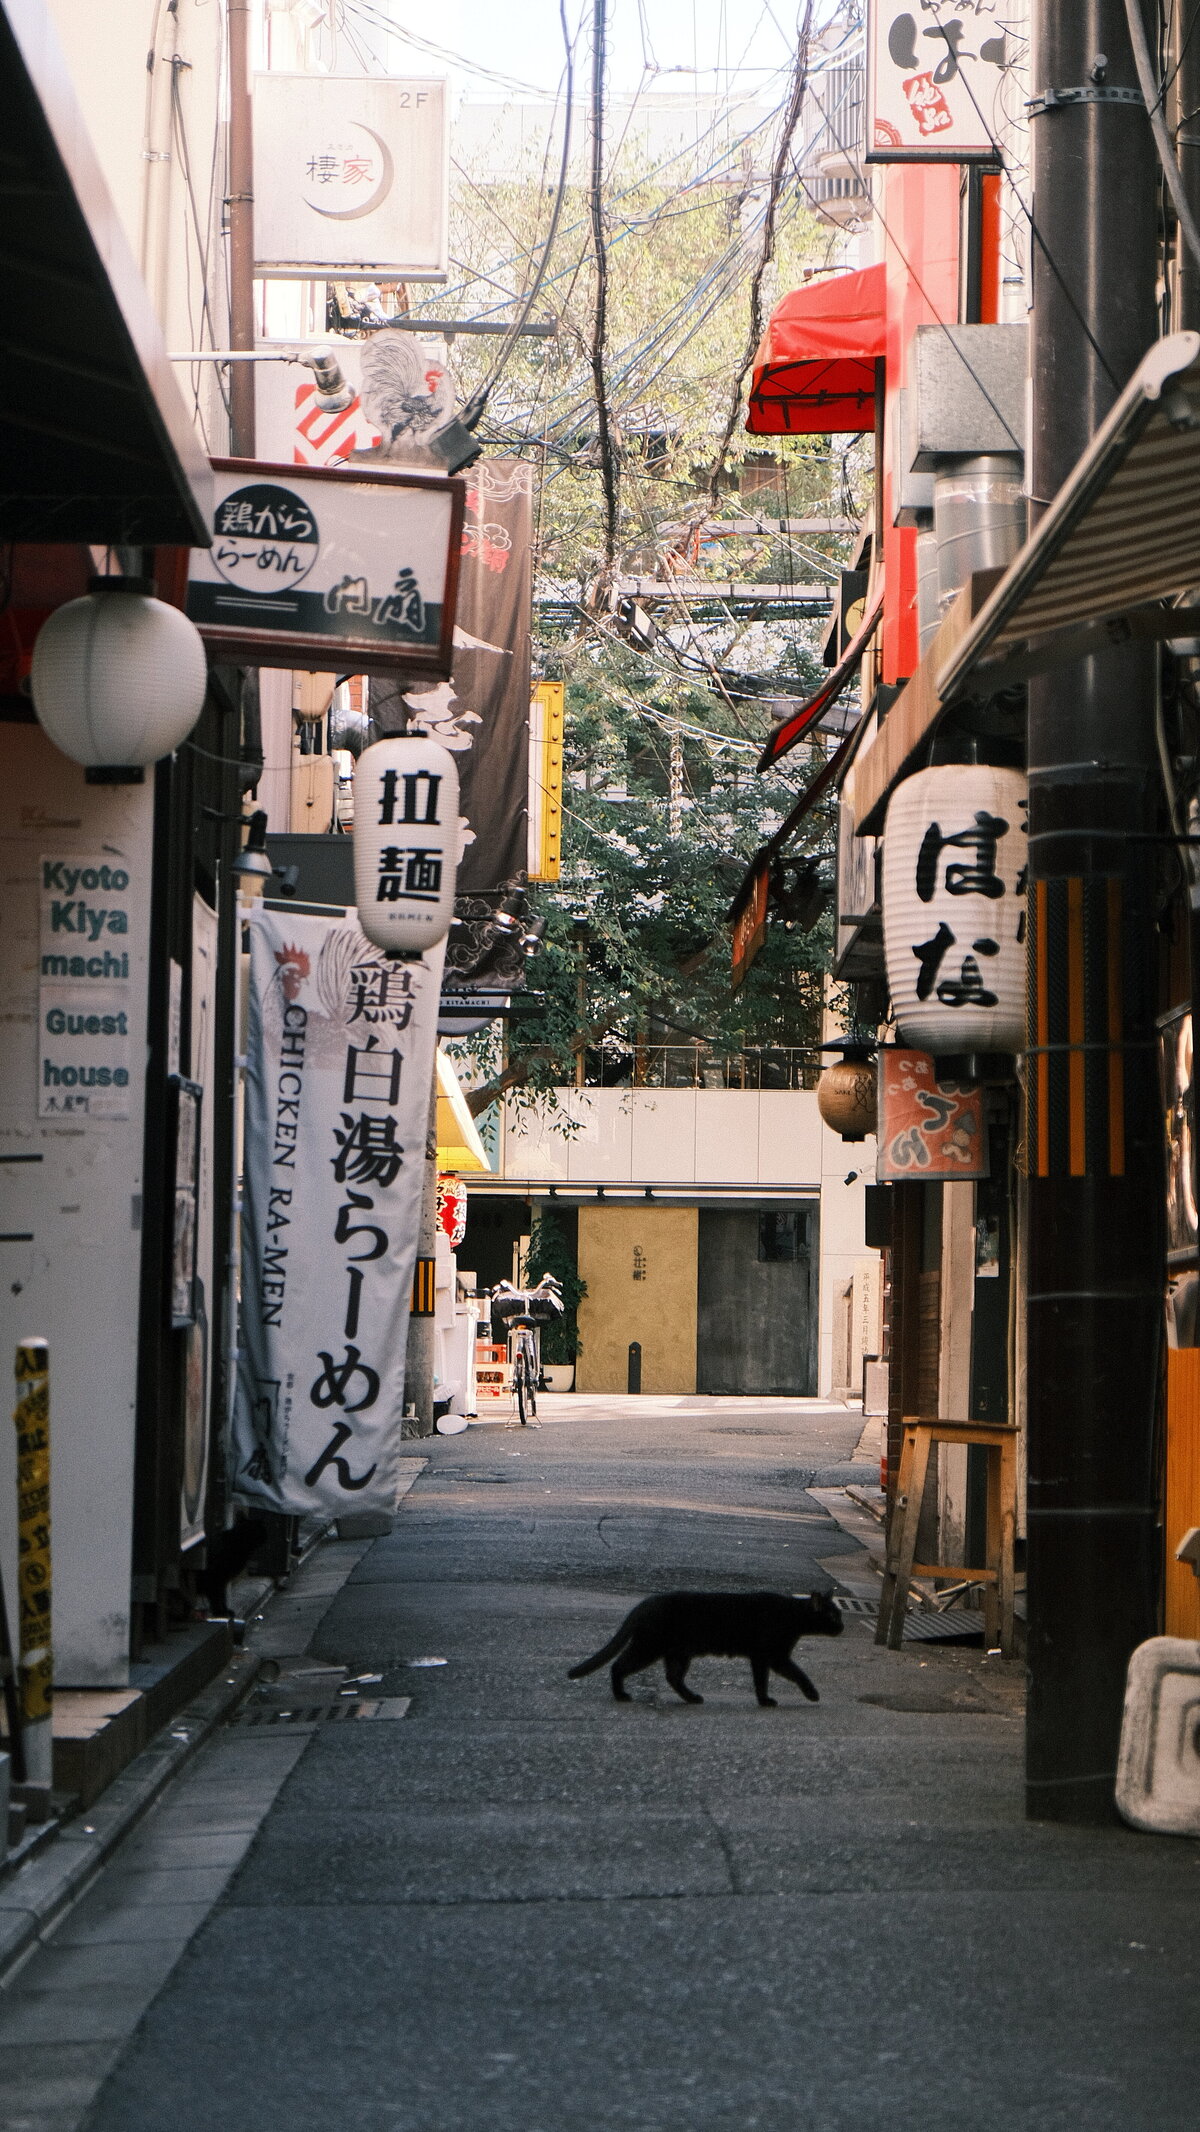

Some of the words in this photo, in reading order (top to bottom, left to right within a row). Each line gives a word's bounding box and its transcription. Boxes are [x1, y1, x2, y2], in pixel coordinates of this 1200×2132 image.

[399, 92, 429, 109] 2F
[306, 155, 375, 185] 棲家
[221, 500, 313, 539] 鶏がら
[217, 540, 305, 573] らーめん
[43, 861, 129, 896] Kyoto
[51, 901, 128, 942] Kiya
[911, 810, 1010, 1008] はな
[41, 951, 129, 979] machi
[46, 1008, 128, 1036] Guest
[43, 1059, 129, 1087] house
[271, 1004, 308, 1169] CHICKEN
[304, 960, 417, 1491] 鶏白湯らーめん
[262, 1187, 293, 1329] RA-MEN
